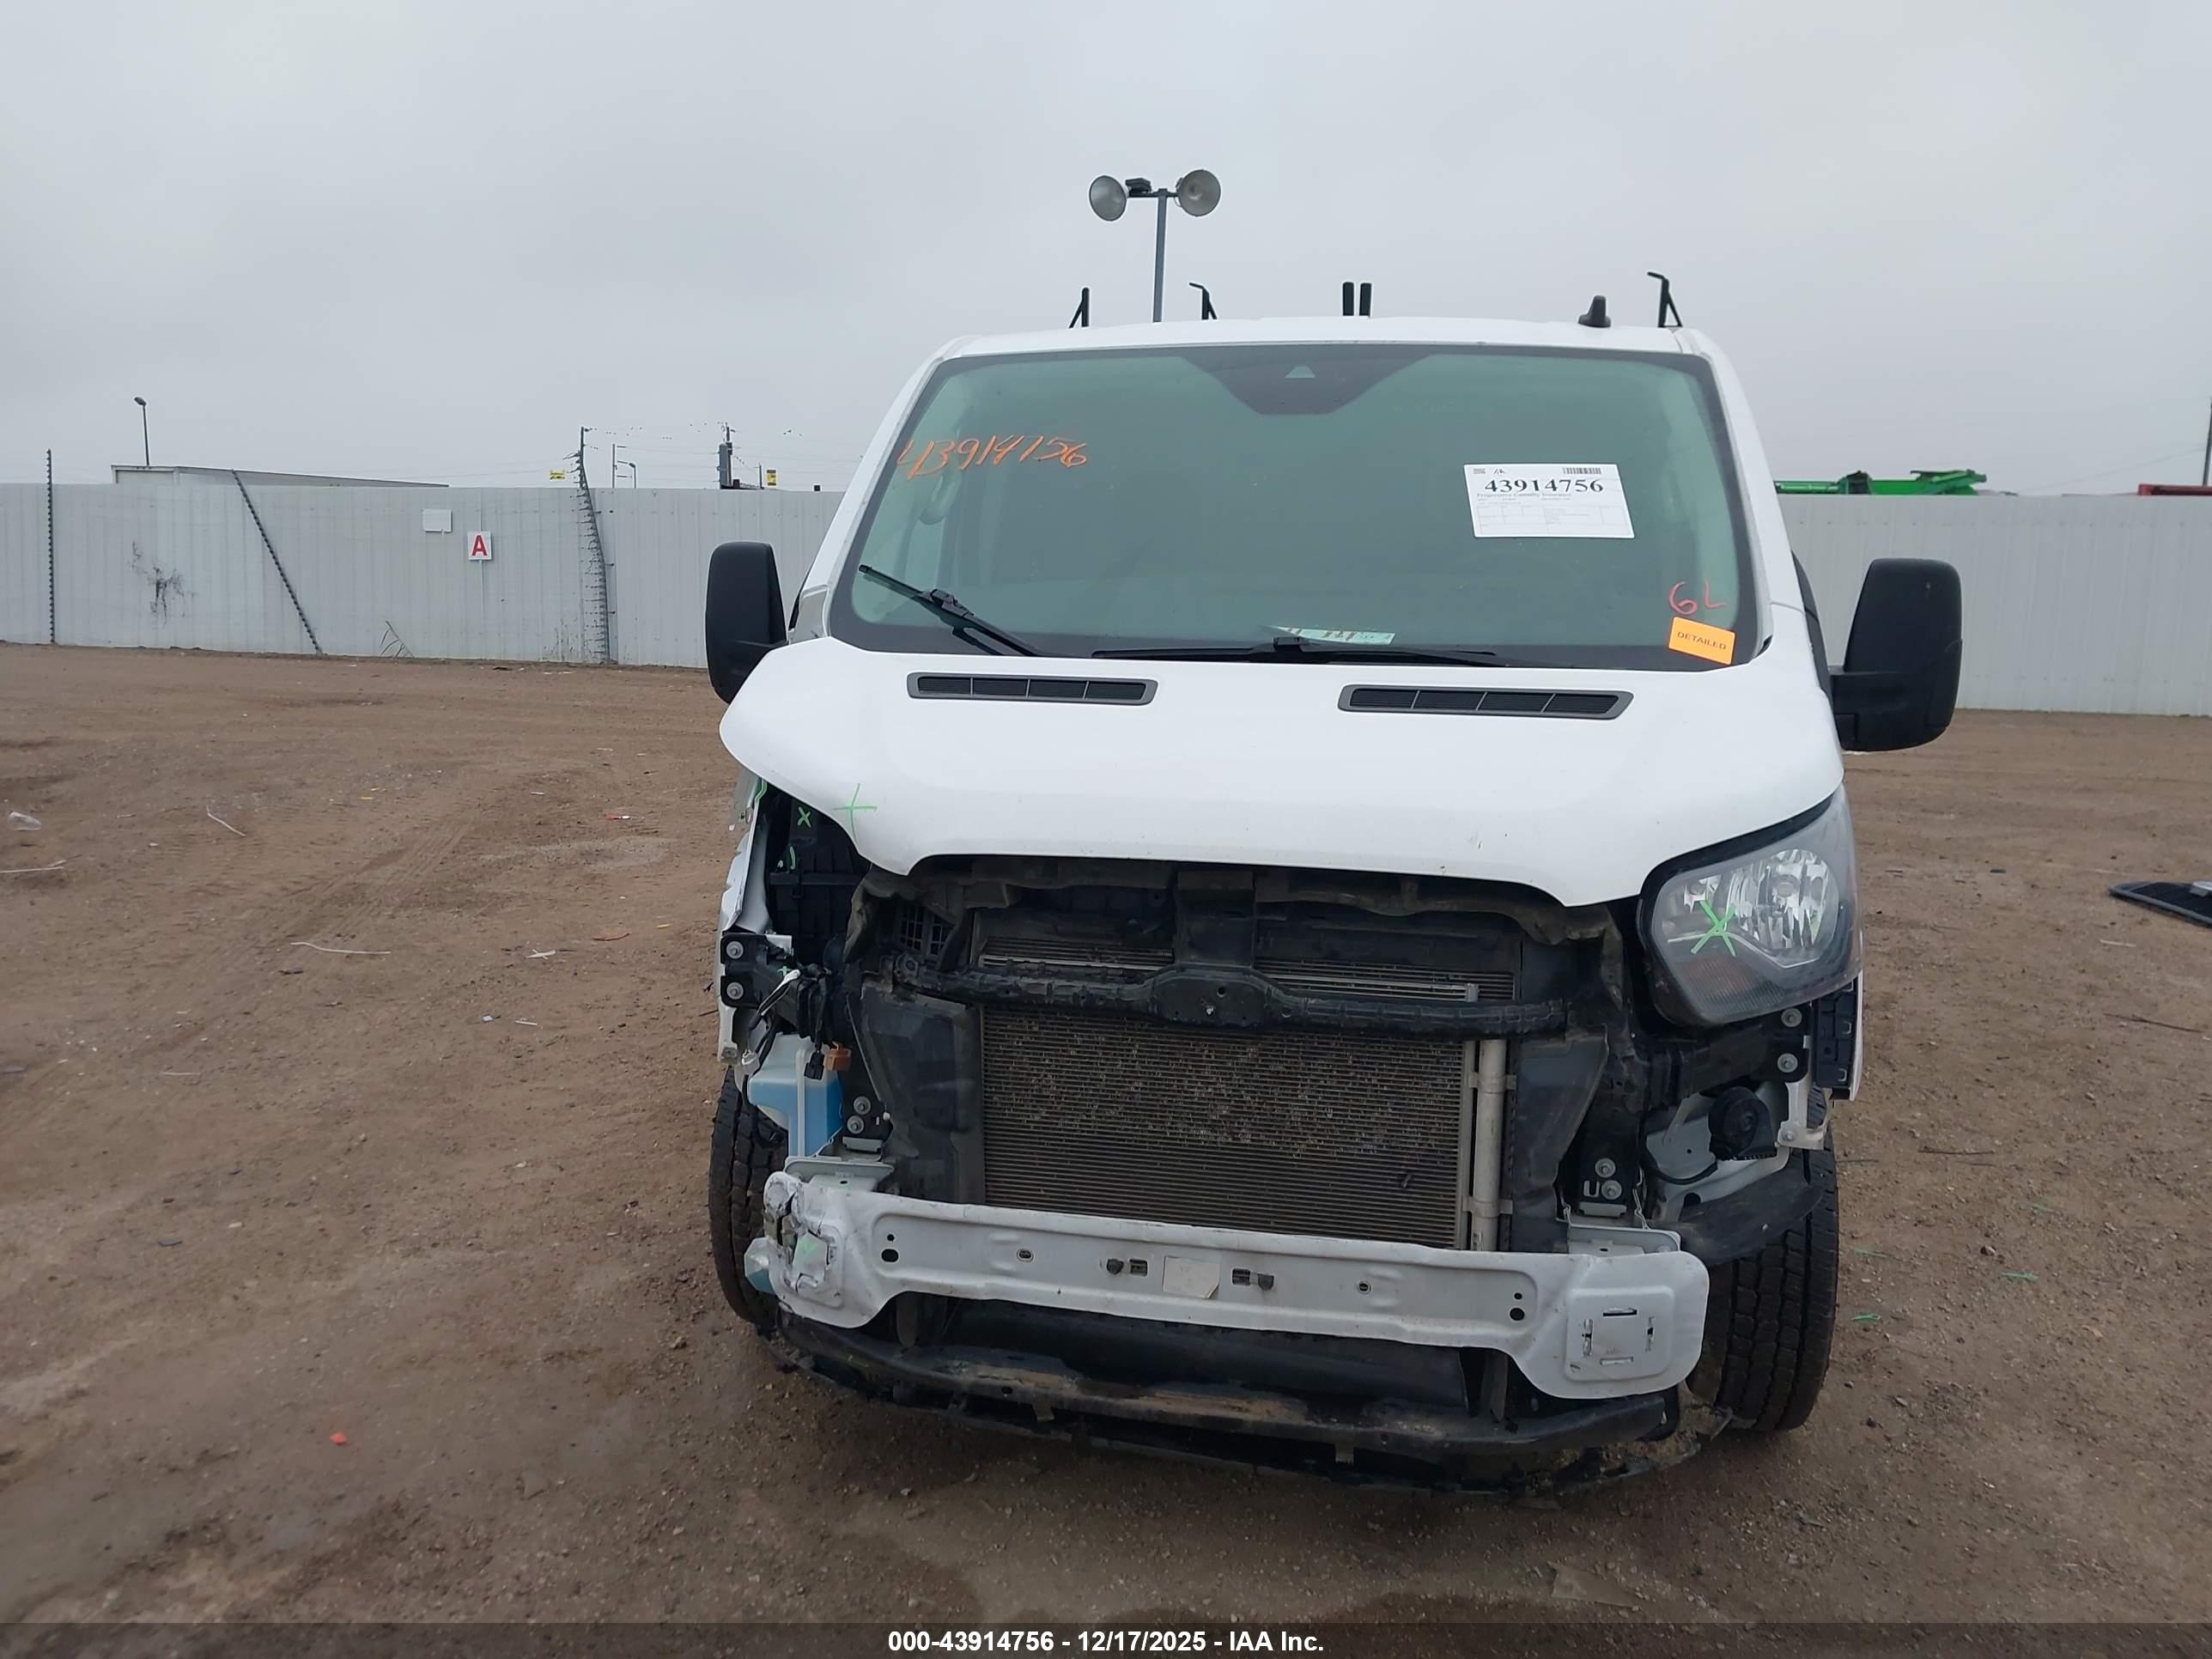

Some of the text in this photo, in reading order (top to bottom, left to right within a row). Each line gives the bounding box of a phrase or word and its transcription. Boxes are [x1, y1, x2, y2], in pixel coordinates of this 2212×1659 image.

[1484, 478, 1604, 493] 43914756
[471, 534, 488, 556] A
[1676, 631, 1727, 651] DETAILED
